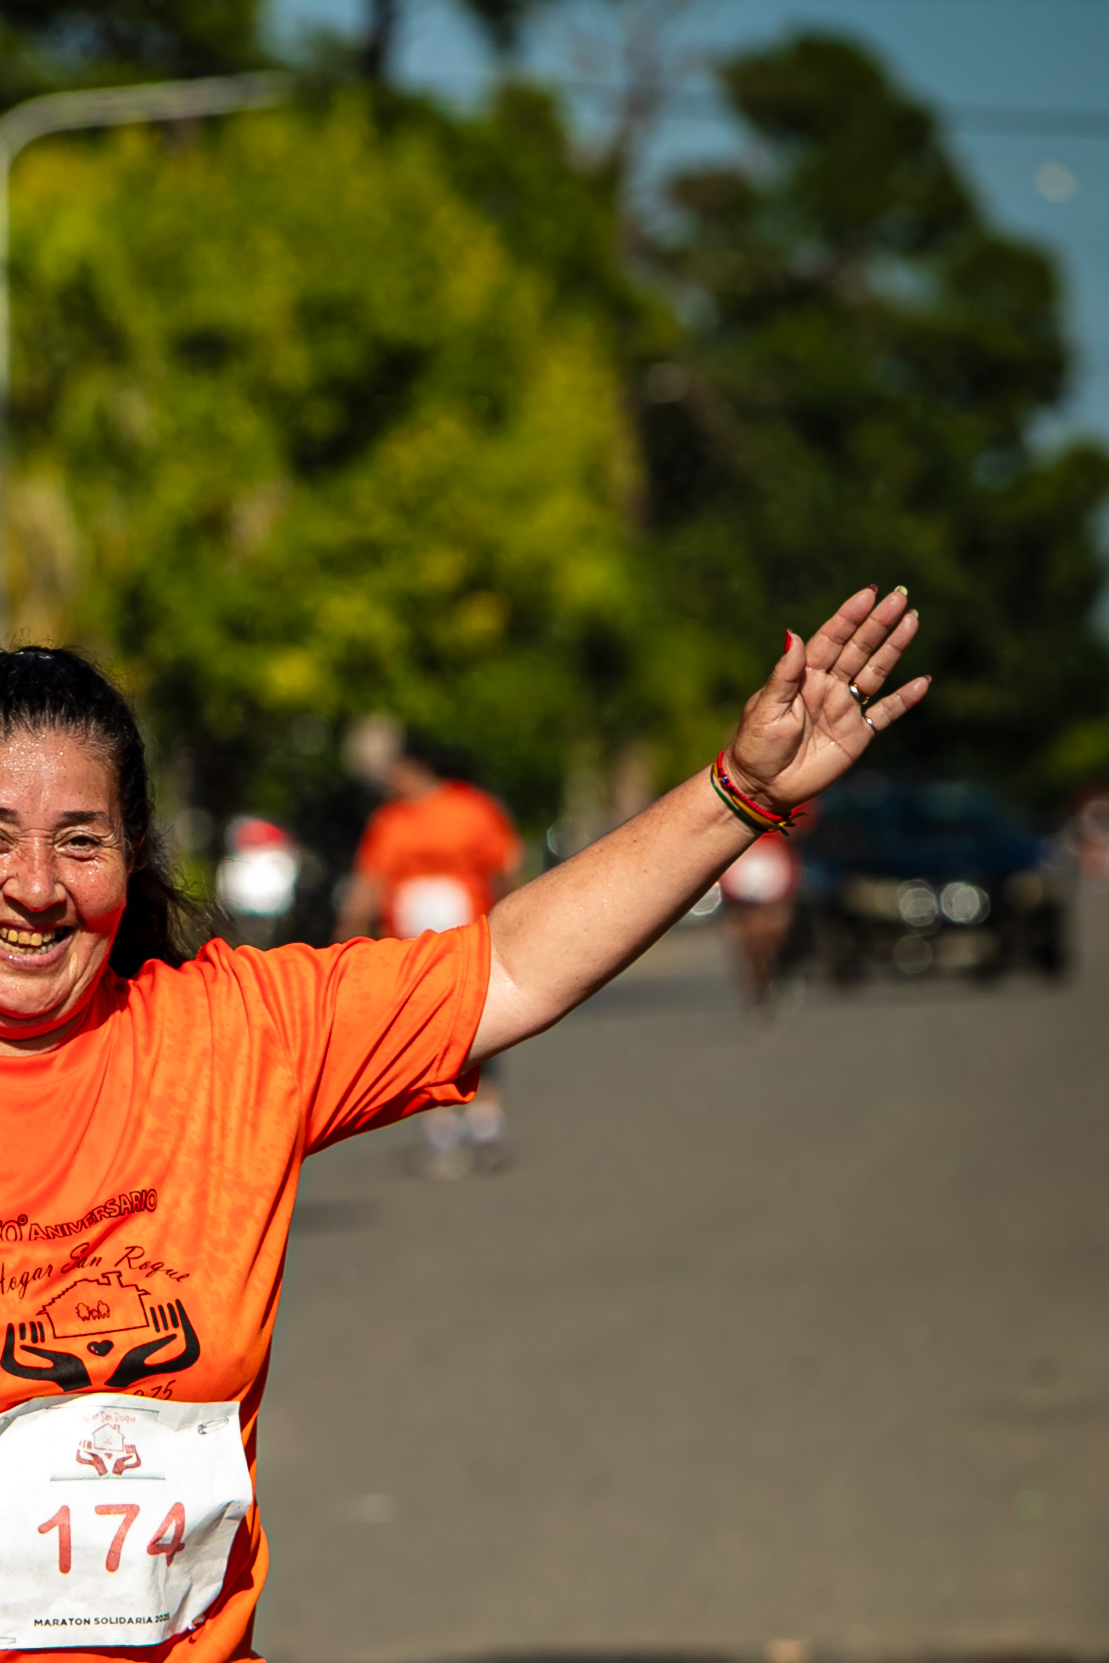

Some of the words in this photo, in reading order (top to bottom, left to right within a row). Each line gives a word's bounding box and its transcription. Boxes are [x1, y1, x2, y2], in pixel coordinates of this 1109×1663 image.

[29, 1189, 157, 1241] ANIVERSARIO
[61, 1242, 102, 1274] San
[114, 1246, 190, 1282] Roque
[38, 1502, 185, 1574] 174
[34, 1617, 91, 1627] MARATON
[93, 1616, 153, 1625] SOLIDARIA
